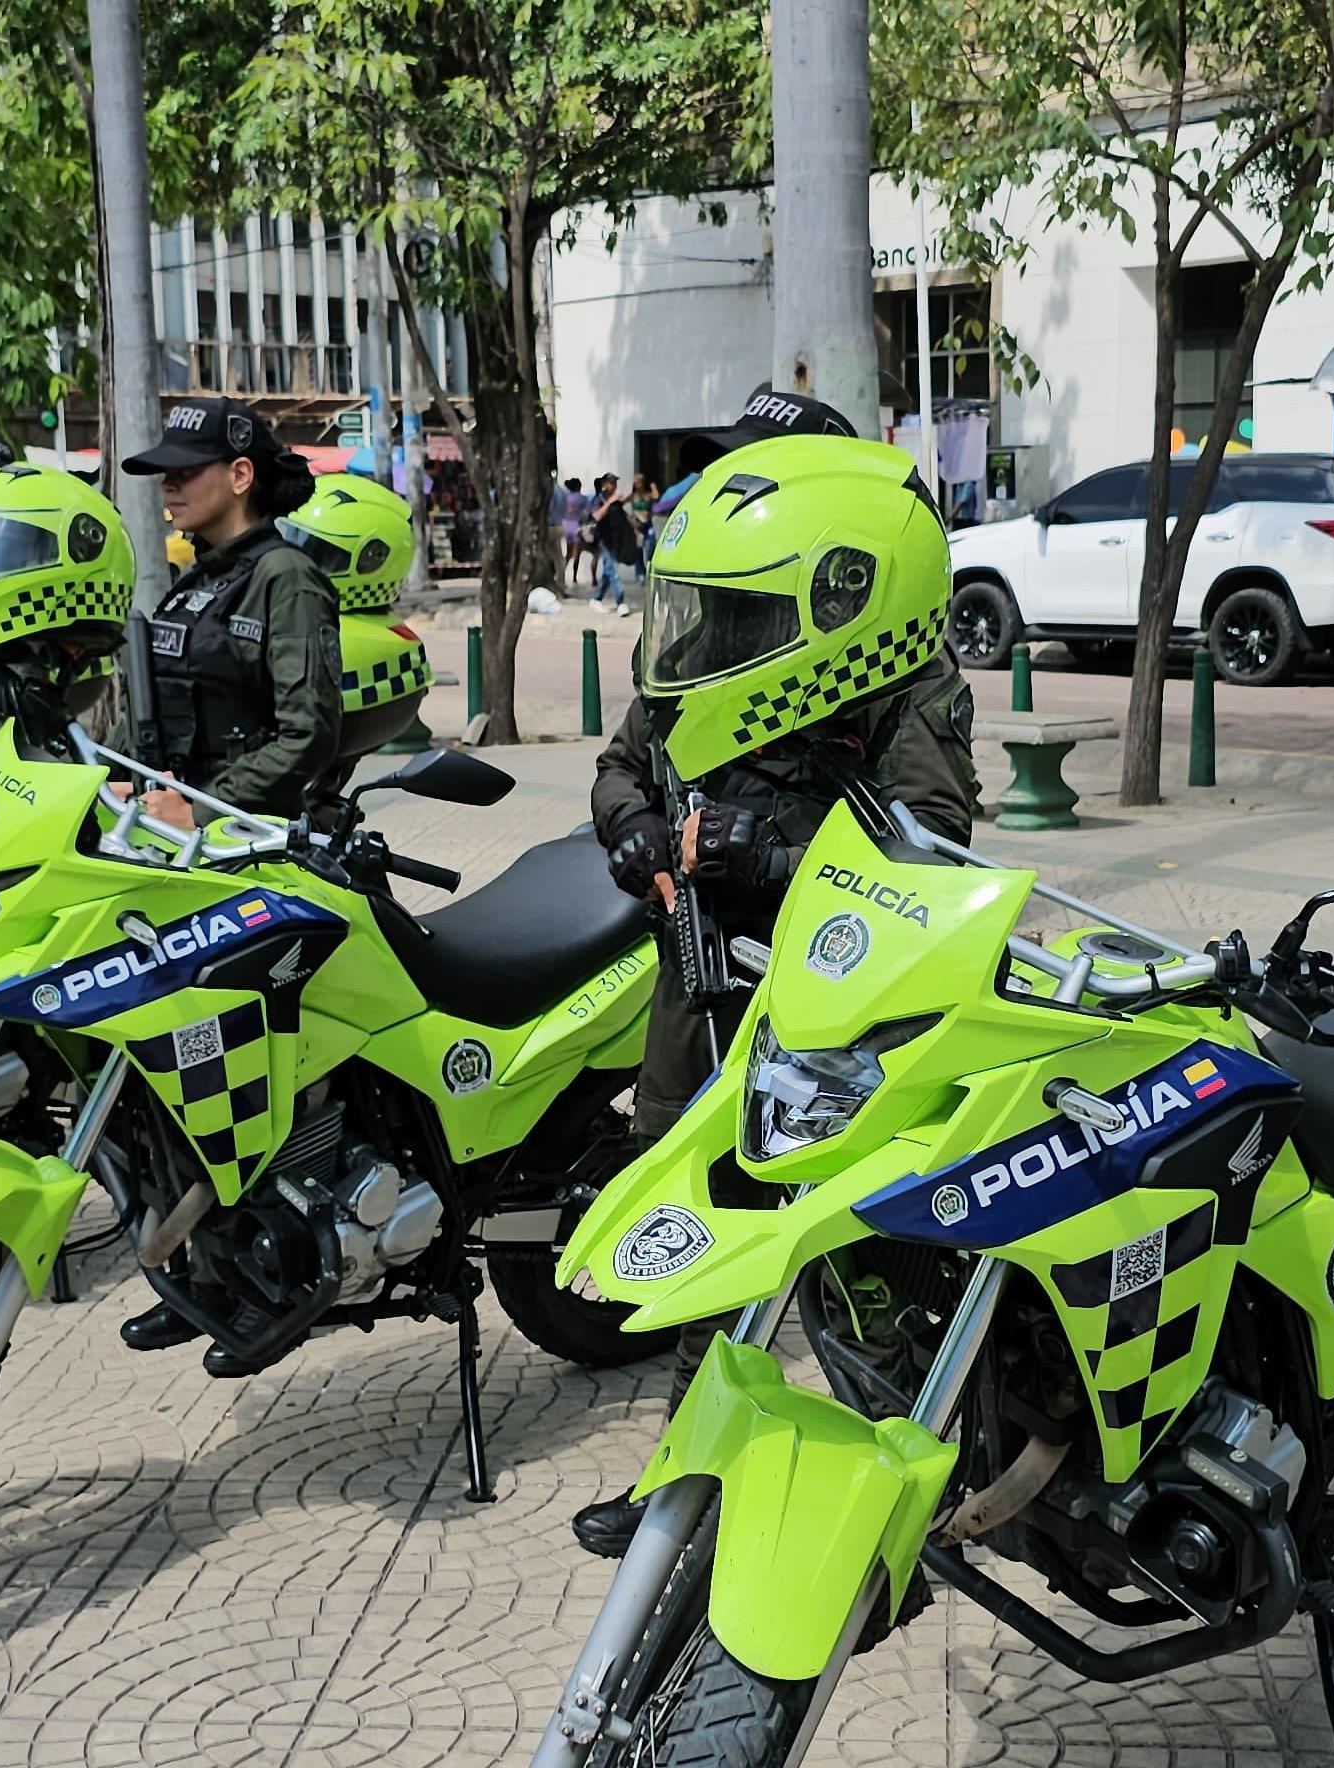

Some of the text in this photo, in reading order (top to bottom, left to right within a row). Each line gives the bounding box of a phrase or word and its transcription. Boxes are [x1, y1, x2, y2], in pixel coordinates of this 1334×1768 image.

[166, 406, 208, 431] BRA
[745, 394, 804, 428] BRA
[815, 863, 929, 929] POLICÍA
[62, 914, 243, 1002] POLICÍA
[271, 967, 313, 989] HONDA
[568, 953, 646, 1019] 57-3701
[970, 1081, 1192, 1208] POLICÍA
[1230, 1152, 1273, 1186] HONDA
